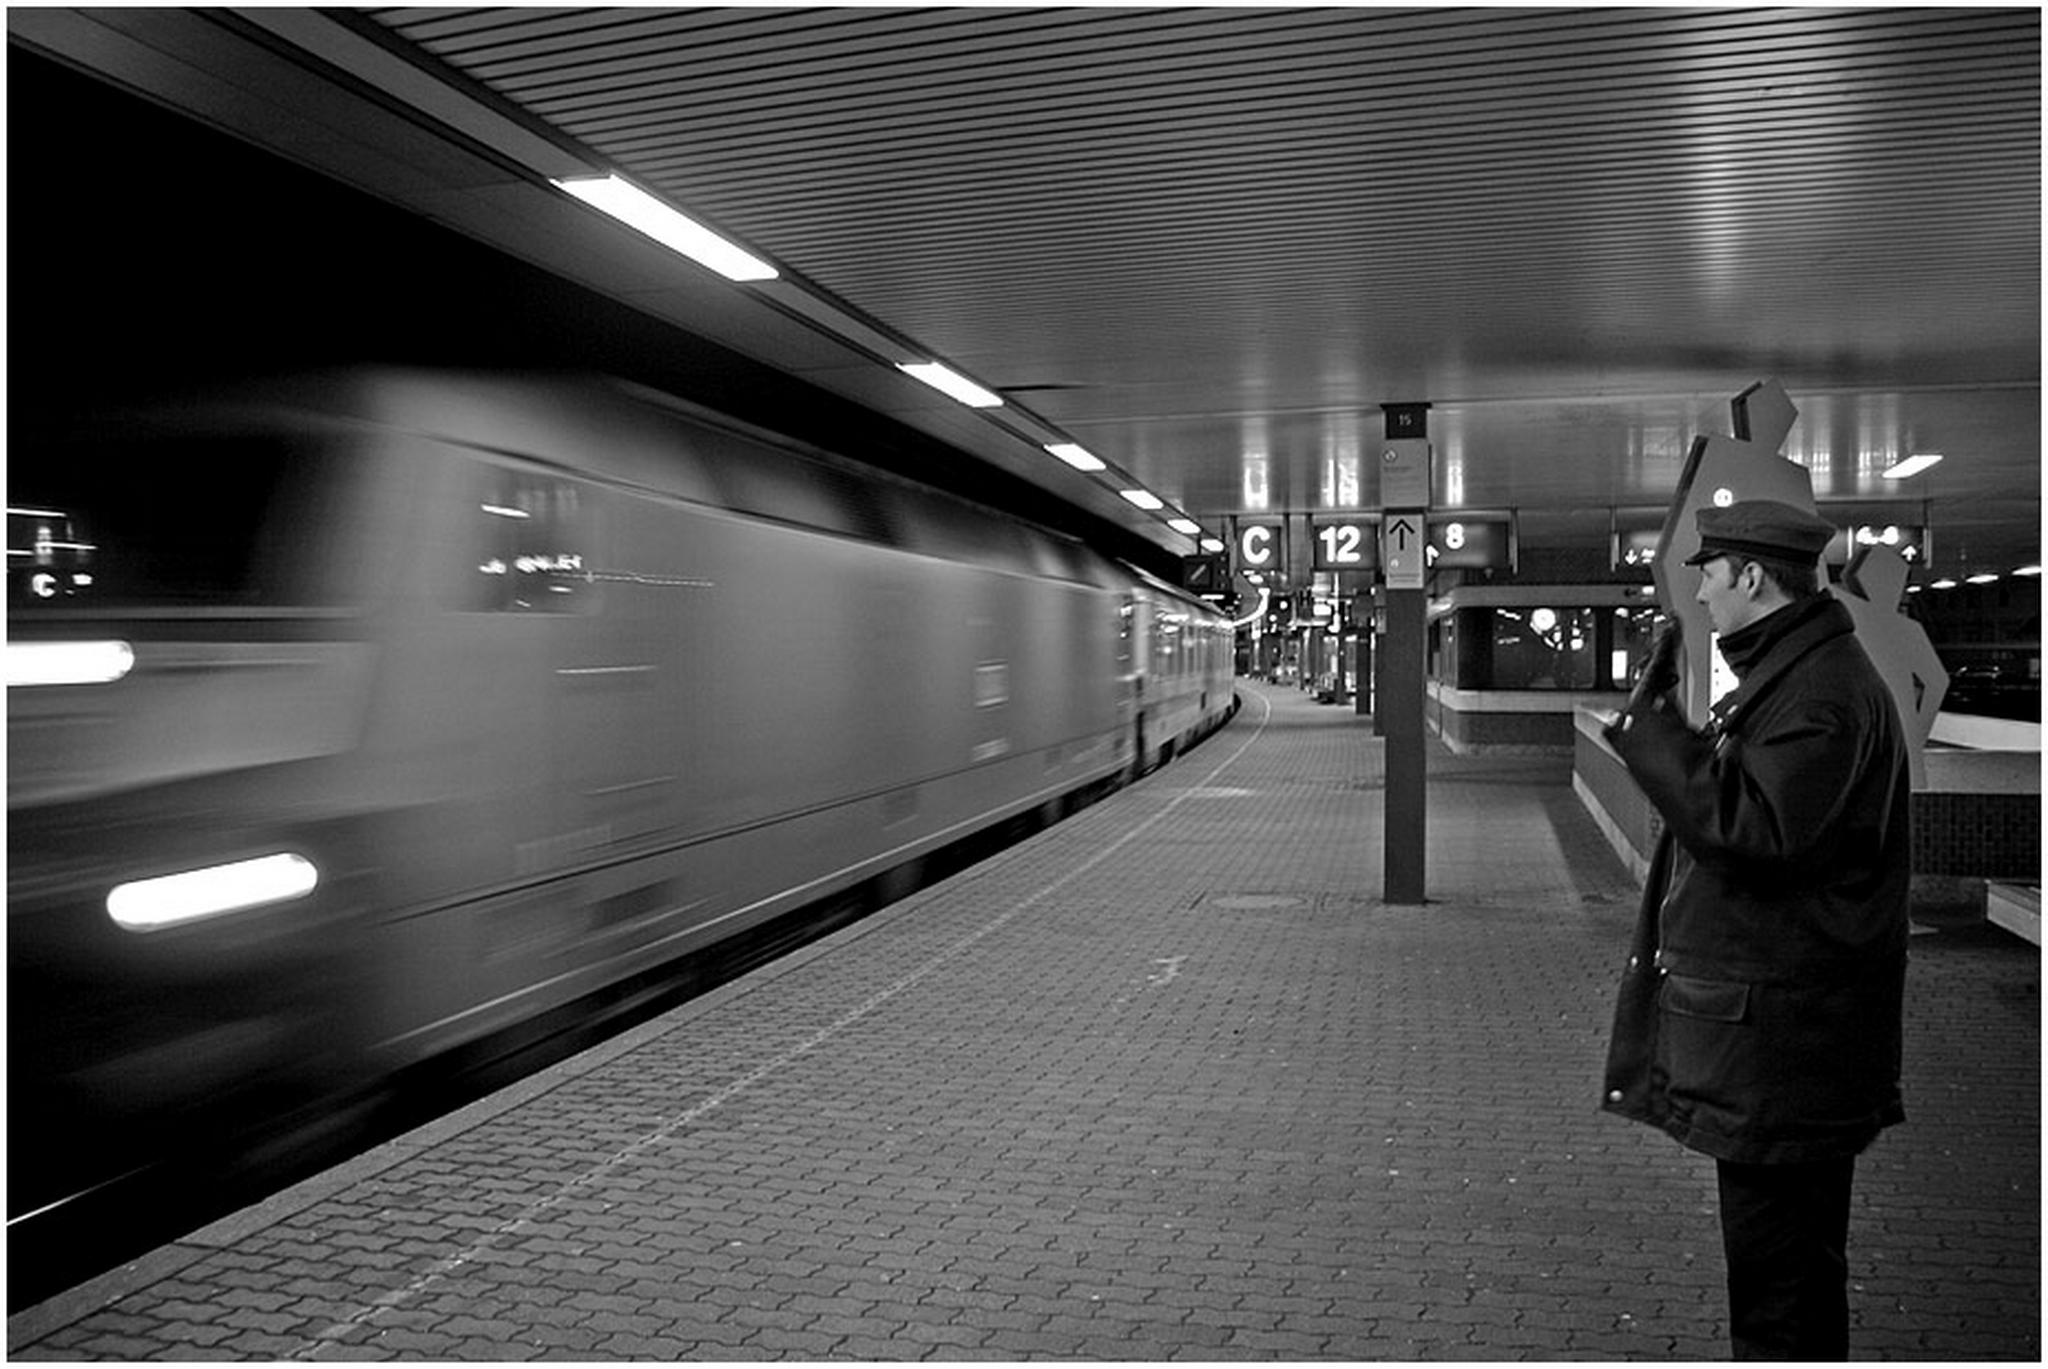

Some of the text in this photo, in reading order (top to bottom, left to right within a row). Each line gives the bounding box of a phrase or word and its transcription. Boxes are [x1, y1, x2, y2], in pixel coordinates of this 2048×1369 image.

[1242, 526, 1270, 564] C
[1319, 525, 1361, 563] 12
[1445, 523, 1465, 549] 8
